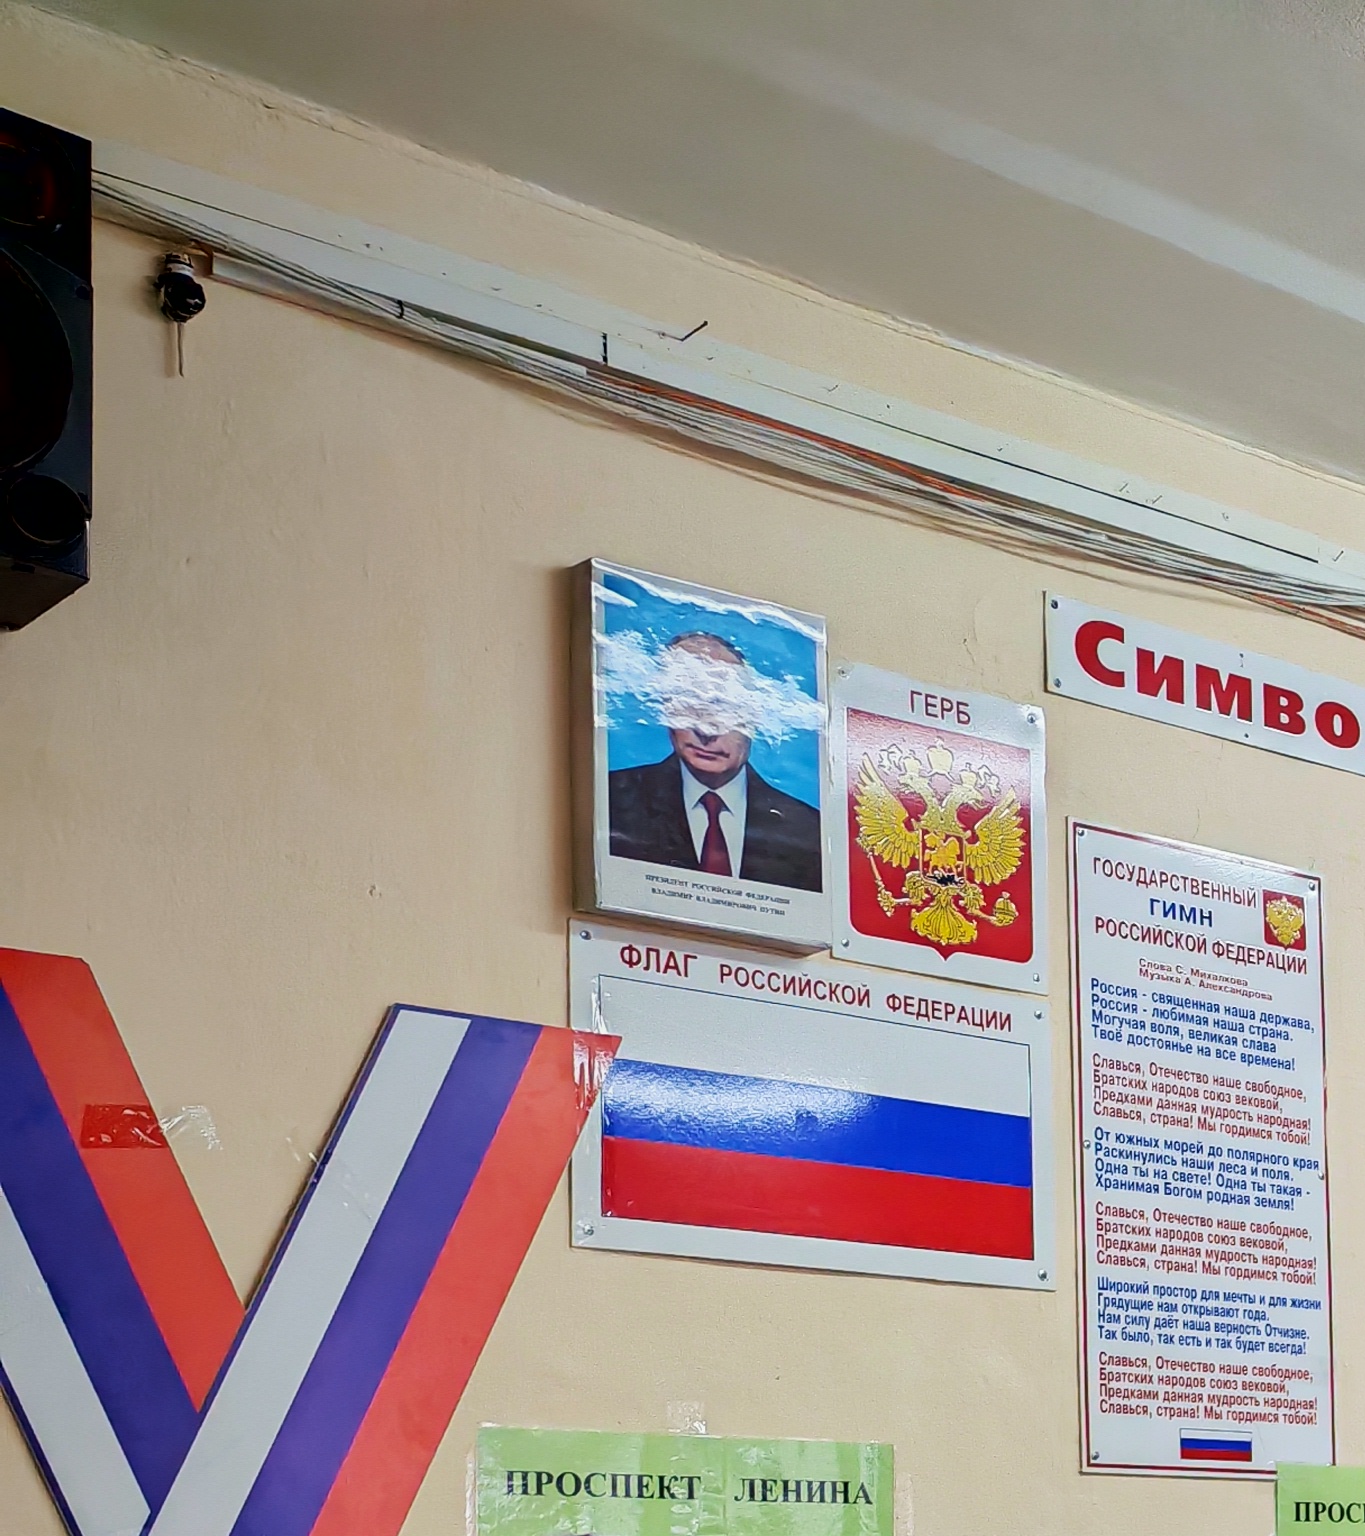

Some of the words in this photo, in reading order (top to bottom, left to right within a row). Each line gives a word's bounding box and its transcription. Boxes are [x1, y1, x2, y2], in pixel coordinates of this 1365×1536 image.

[908, 690, 971, 726] ГЕРБ
[1092, 855, 1256, 909] ГОСУДАРСТВЕННЫЙ
[1149, 896, 1213, 928] ГИМН
[1094, 915, 1207, 955] РОССИЙСКОЙ
[1211, 938, 1307, 975] ФЕДЕРАЦИИ
[620, 943, 698, 978] ФЛАГ
[720, 964, 871, 1008] РОССИЙСКОЙ
[886, 993, 1012, 1033] ФЕДЕРАЦИИ
[1090, 977, 1138, 999] Россия
[1151, 991, 1220, 1014] священная
[1223, 1004, 1256, 1020] наша
[1258, 1011, 1314, 1036] держава,
[1090, 992, 1138, 1014] Россия
[1150, 1006, 1209, 1027] любимая
[1212, 1017, 1245, 1033] наша
[1247, 1023, 1293, 1042] страна.
[1091, 1008, 1146, 1033] Могучая
[1149, 1021, 1184, 1043] воля,
[1187, 1028, 1238, 1047] великая
[1240, 1037, 1276, 1053] слава
[1090, 1023, 1123, 1042] Твоё
[1126, 1032, 1193, 1054] достоянье
[1196, 1044, 1211, 1057] на
[1214, 1047, 1237, 1061] все
[1239, 1051, 1295, 1071] времена!
[1091, 1052, 1145, 1080] Славься,
[1148, 1061, 1209, 1084] Отечество
[1212, 1074, 1242, 1090] наше
[1244, 1079, 1306, 1105] свободное,
[1092, 1068, 1148, 1090] Братских
[1150, 1080, 1200, 1100] народов
[1202, 1088, 1231, 1103] союз
[1234, 1093, 1283, 1116] вековой,
[1092, 1084, 1153, 1106] Предками
[1155, 1097, 1197, 1113] данная
[1200, 1103, 1254, 1123] мудрость
[1256, 1112, 1311, 1130] народная!
[1092, 1100, 1146, 1127] Славься,
[1149, 1112, 1193, 1130] страна!
[1196, 1115, 1216, 1131] Мы
[1219, 1122, 1273, 1140] гордимся
[1274, 1129, 1310, 1145] тобой!
[1093, 1125, 1111, 1142] От
[1114, 1131, 1160, 1149] южных
[1163, 1138, 1204, 1158] морей
[1206, 1144, 1223, 1160] до
[1226, 1147, 1290, 1168] полярного
[1292, 1156, 1319, 1174] края
[1093, 1141, 1178, 1168] Раскинулись
[1180, 1156, 1215, 1171] наши
[1217, 1161, 1247, 1175] леса
[1249, 1165, 1258, 1176] и
[1261, 1167, 1294, 1181] поля.
[1093, 1157, 1128, 1176] Одна
[1131, 1165, 1149, 1178] ты
[1152, 1168, 1168, 1180] на
[1170, 1170, 1211, 1186] свете!
[1215, 1172, 1247, 1191] Одна
[1250, 1180, 1267, 1193] ты
[1268, 1182, 1302, 1197] такая
[1094, 1172, 1160, 1194] Хранимая
[1163, 1181, 1202, 1200] Богом
[1205, 1190, 1250, 1206] родная
[1253, 1195, 1294, 1211] земля!
[1096, 1276, 1149, 1297] Широкий
[1152, 1284, 1198, 1304] простор
[1199, 1288, 1220, 1303] для
[1222, 1291, 1256, 1304] мечты
[1258, 1294, 1266, 1305] и
[1267, 1295, 1287, 1309] для
[1289, 1297, 1321, 1310] жизни
[1097, 1292, 1154, 1314] Грядущие
[1156, 1300, 1178, 1313] нам
[1180, 1303, 1240, 1321] открывают
[1242, 1308, 1269, 1323] года.
[506, 1470, 701, 1500] ПРОСПЕКТ
[735, 1478, 873, 1505] ЛЕНИНА
